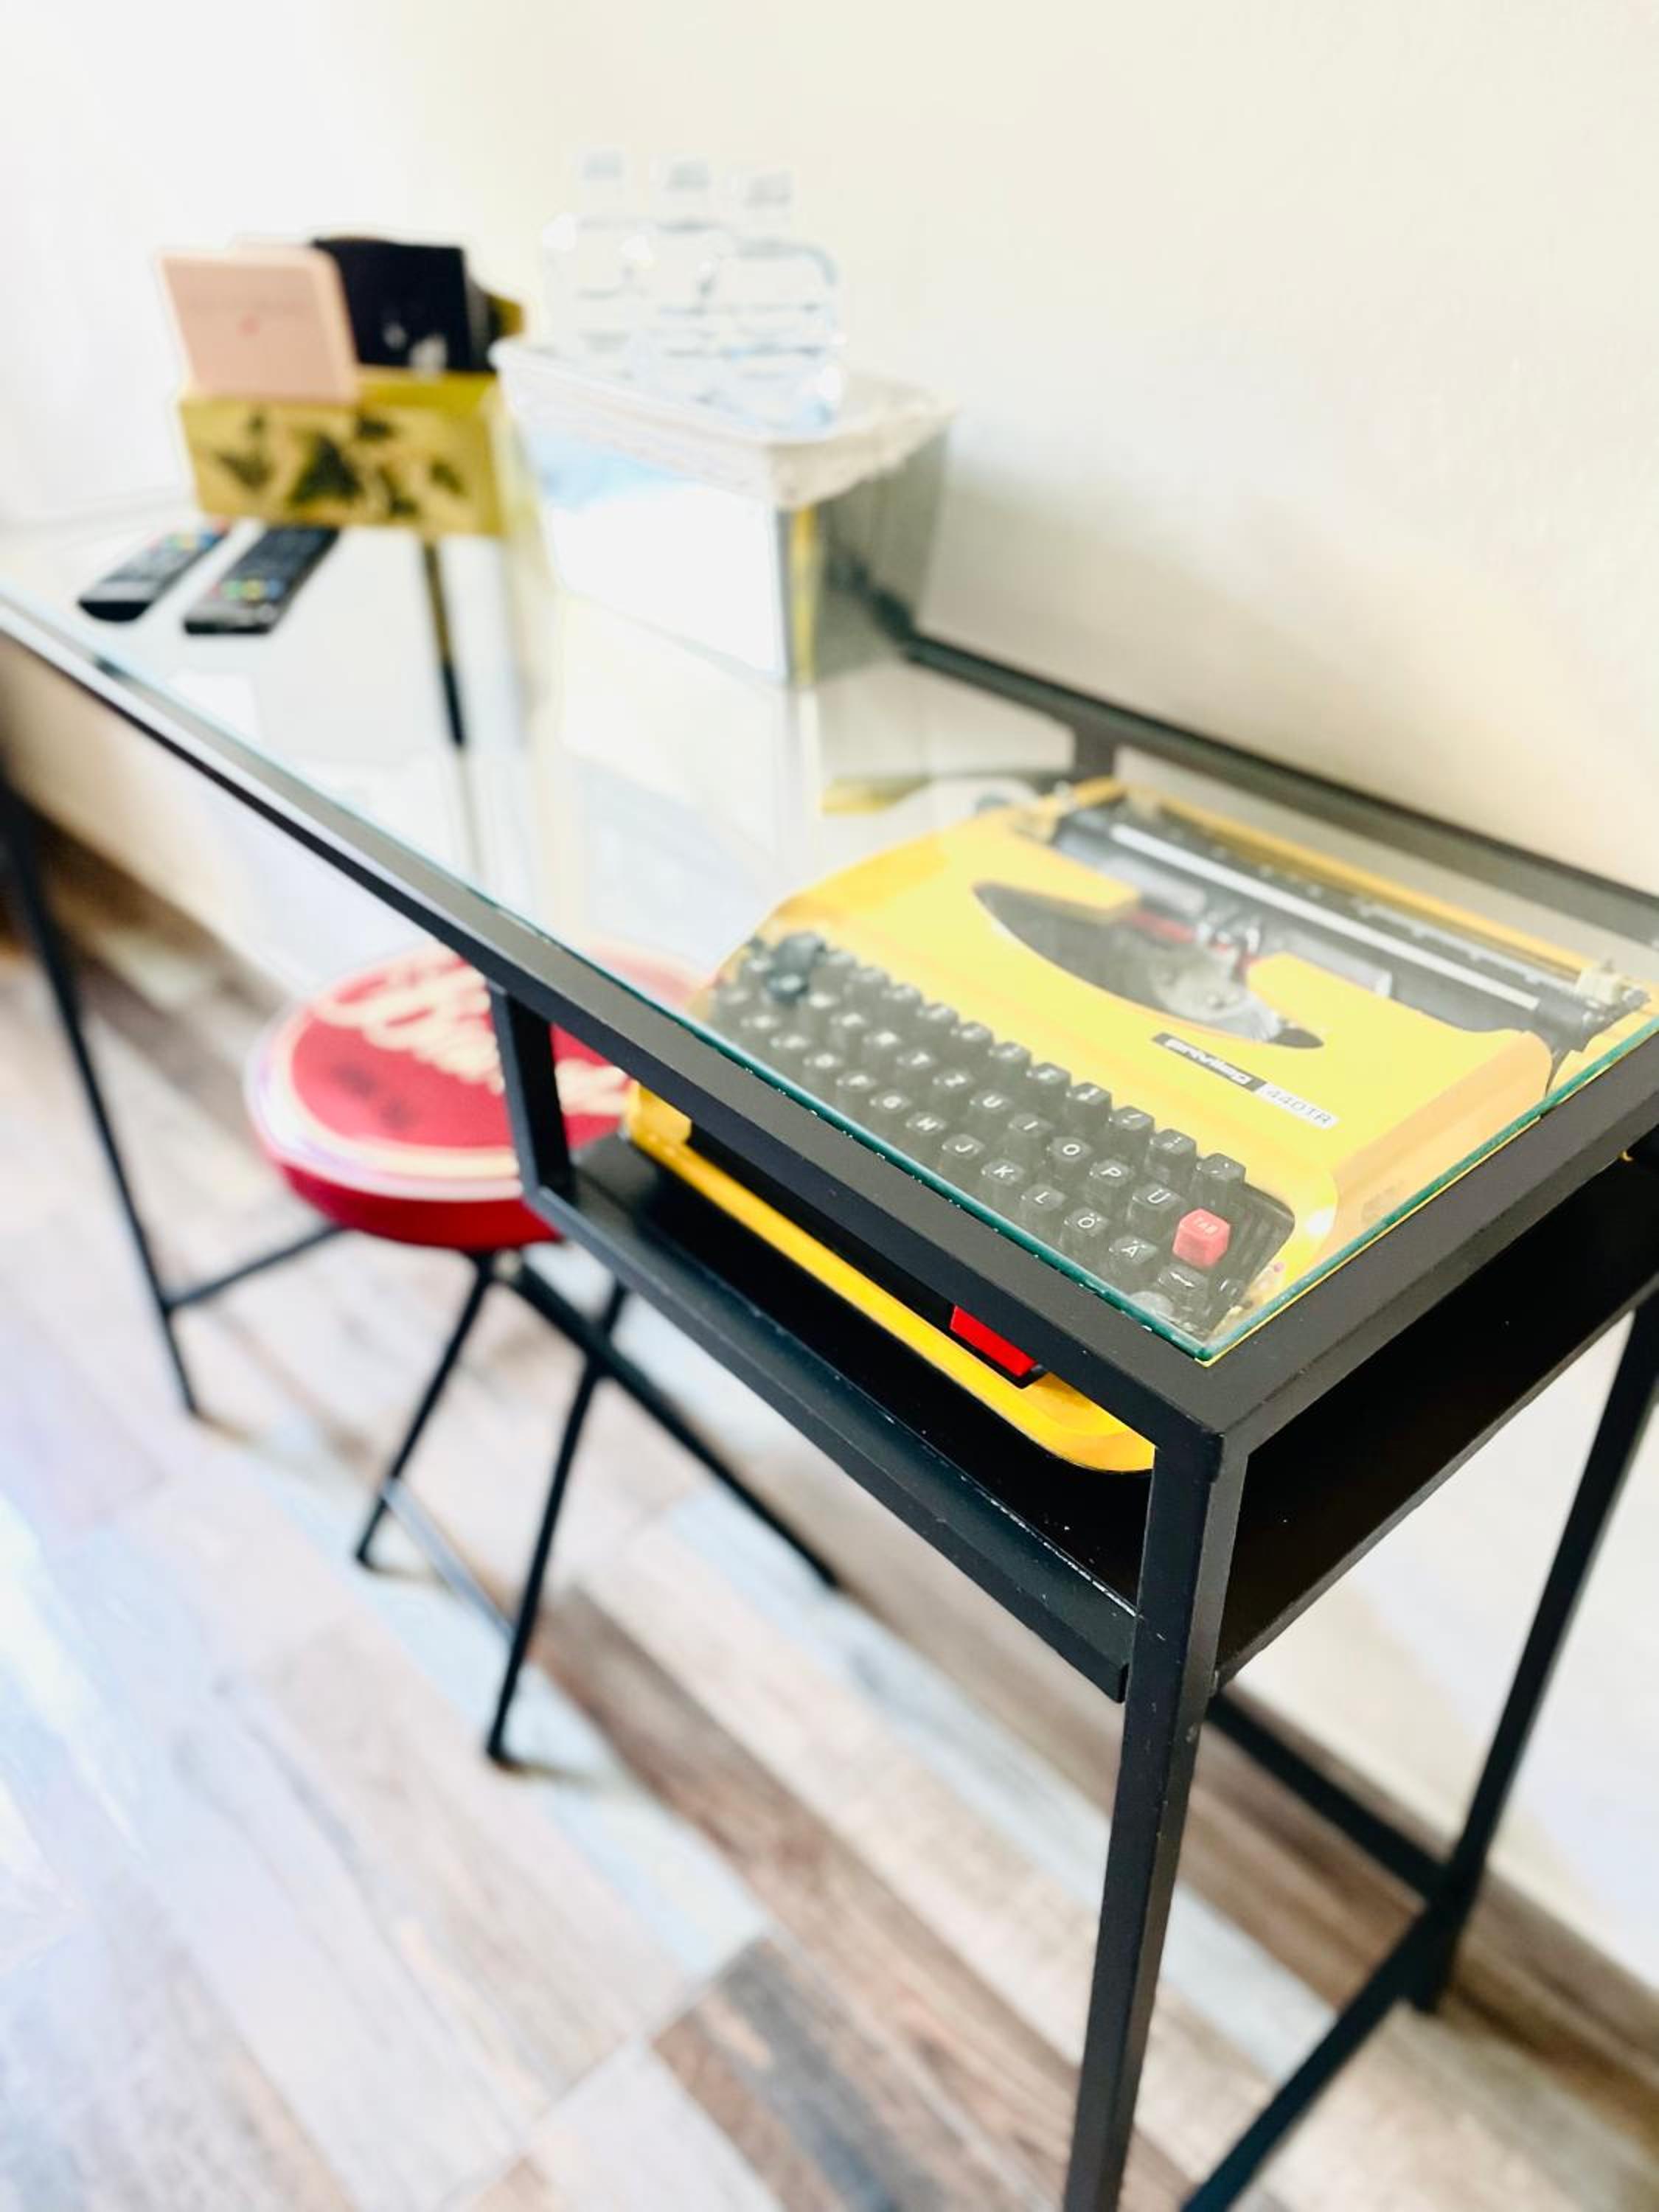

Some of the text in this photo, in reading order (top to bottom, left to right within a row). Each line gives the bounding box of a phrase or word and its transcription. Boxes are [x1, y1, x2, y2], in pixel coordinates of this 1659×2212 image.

[992, 1165, 1015, 1178] K
[1101, 1167, 1122, 1178] P
[1034, 1191, 1050, 1204] L
